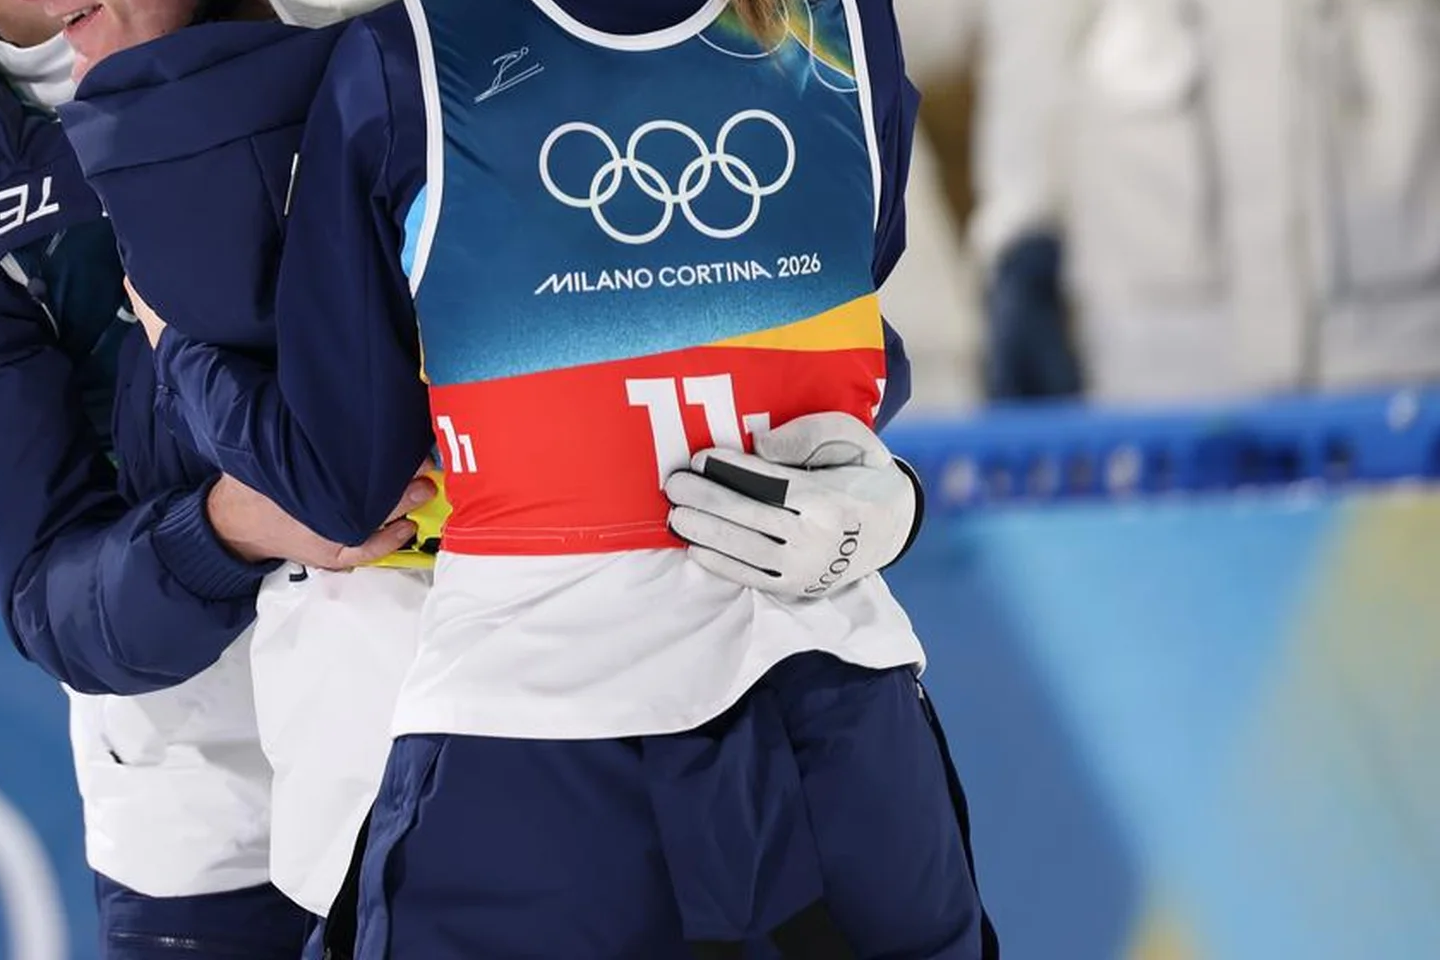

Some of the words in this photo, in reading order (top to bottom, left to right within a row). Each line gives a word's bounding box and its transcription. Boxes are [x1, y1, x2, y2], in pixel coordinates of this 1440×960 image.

[534, 268, 653, 295] MILANO
[658, 260, 772, 287] CORTINA
[777, 252, 822, 278] 2026
